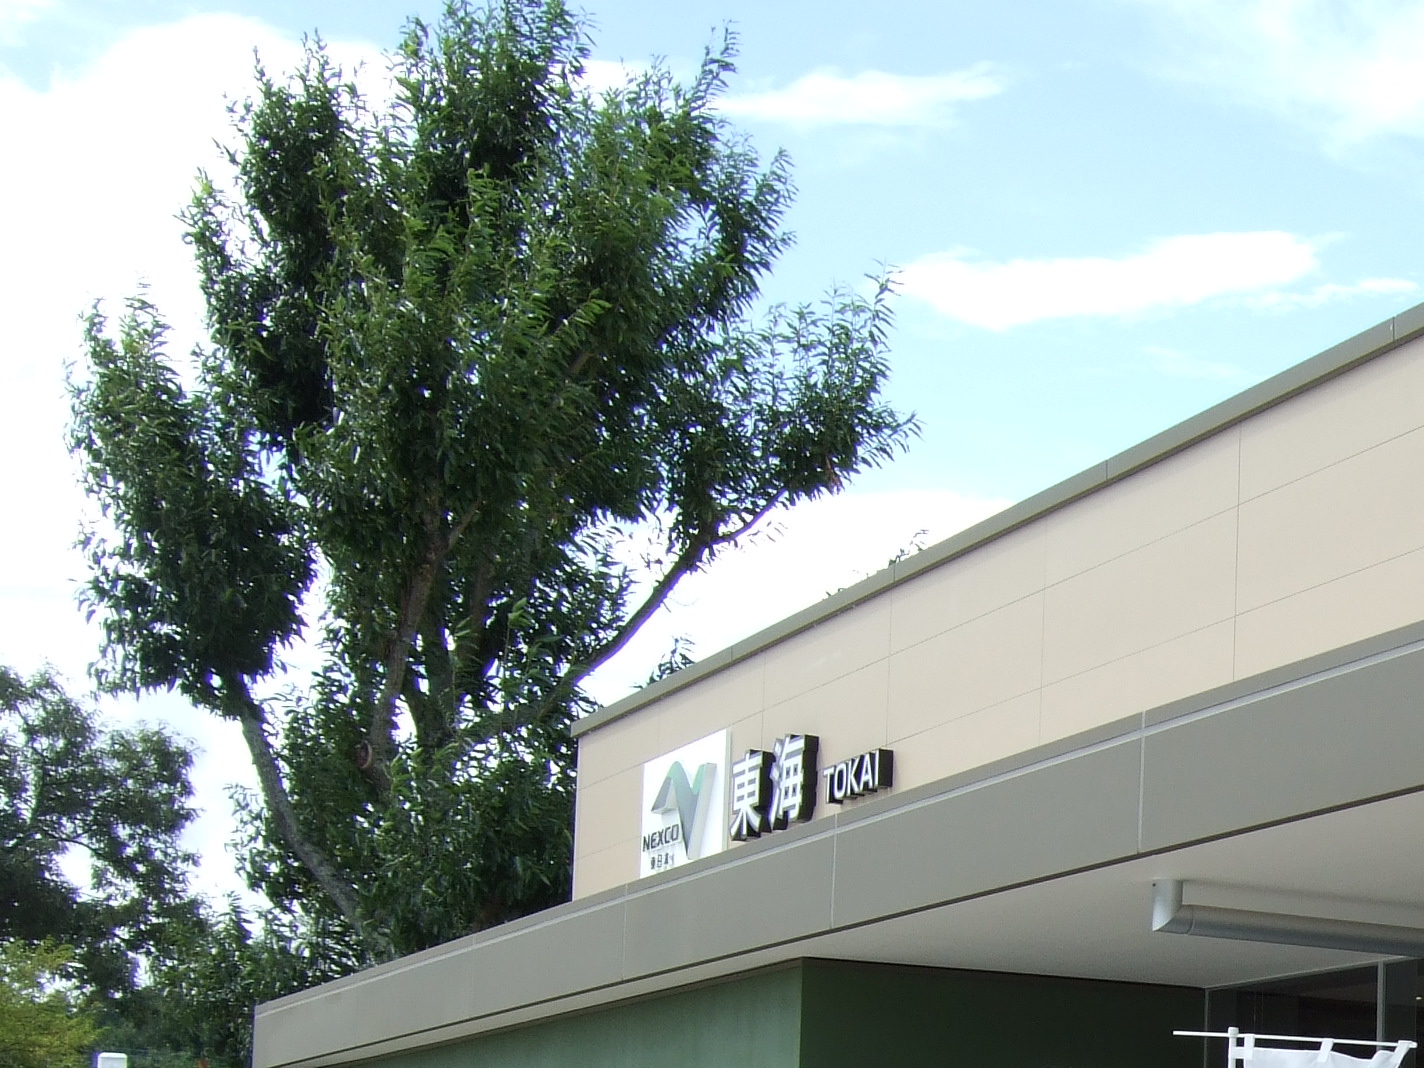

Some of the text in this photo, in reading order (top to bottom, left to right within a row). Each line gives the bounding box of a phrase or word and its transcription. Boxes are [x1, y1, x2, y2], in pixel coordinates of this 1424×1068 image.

[730, 734, 882, 841] 東海 TOKAI
[643, 824, 680, 852] NEXCO
